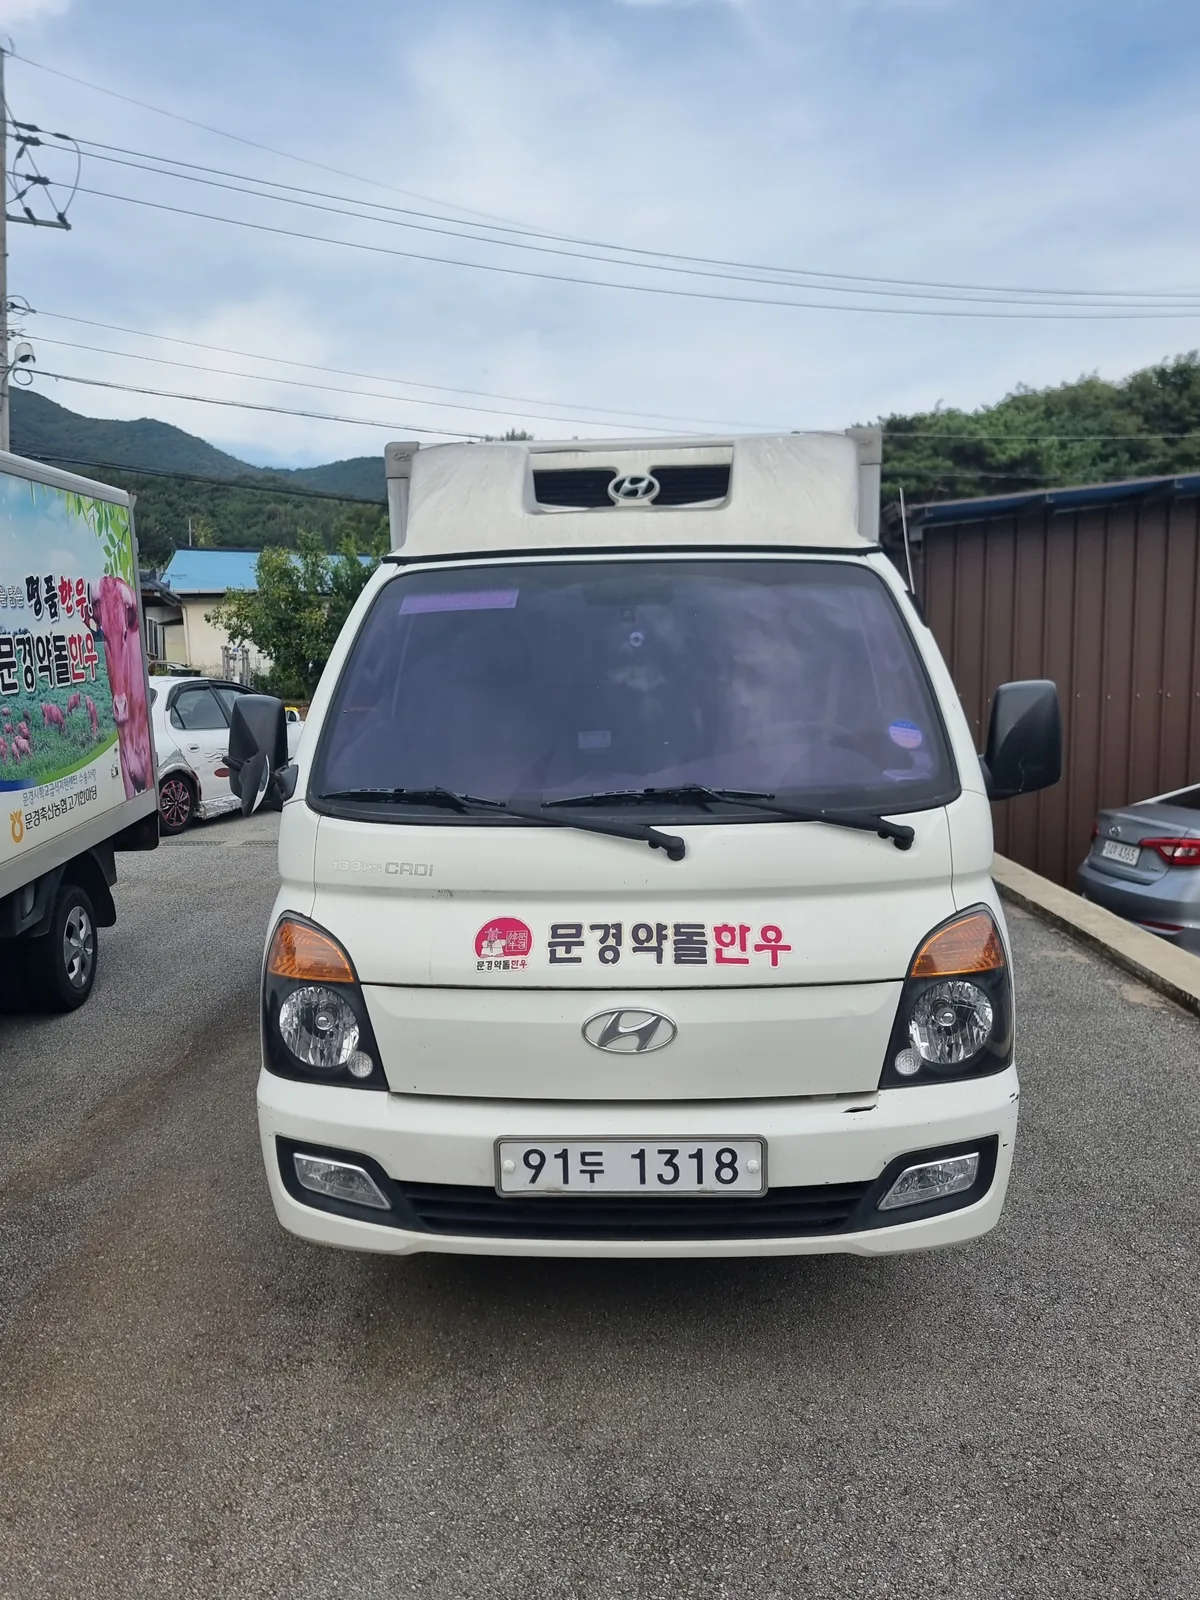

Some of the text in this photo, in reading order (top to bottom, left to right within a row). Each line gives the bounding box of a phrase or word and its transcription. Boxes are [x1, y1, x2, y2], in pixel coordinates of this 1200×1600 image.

[0, 633, 98, 692] 문경약돌한우
[384, 862, 434, 876] CRDi
[547, 922, 793, 967] 문경약돌한우
[476, 959, 528, 971] 문경약돌한우
[522, 1147, 740, 1186] 91두 1318
